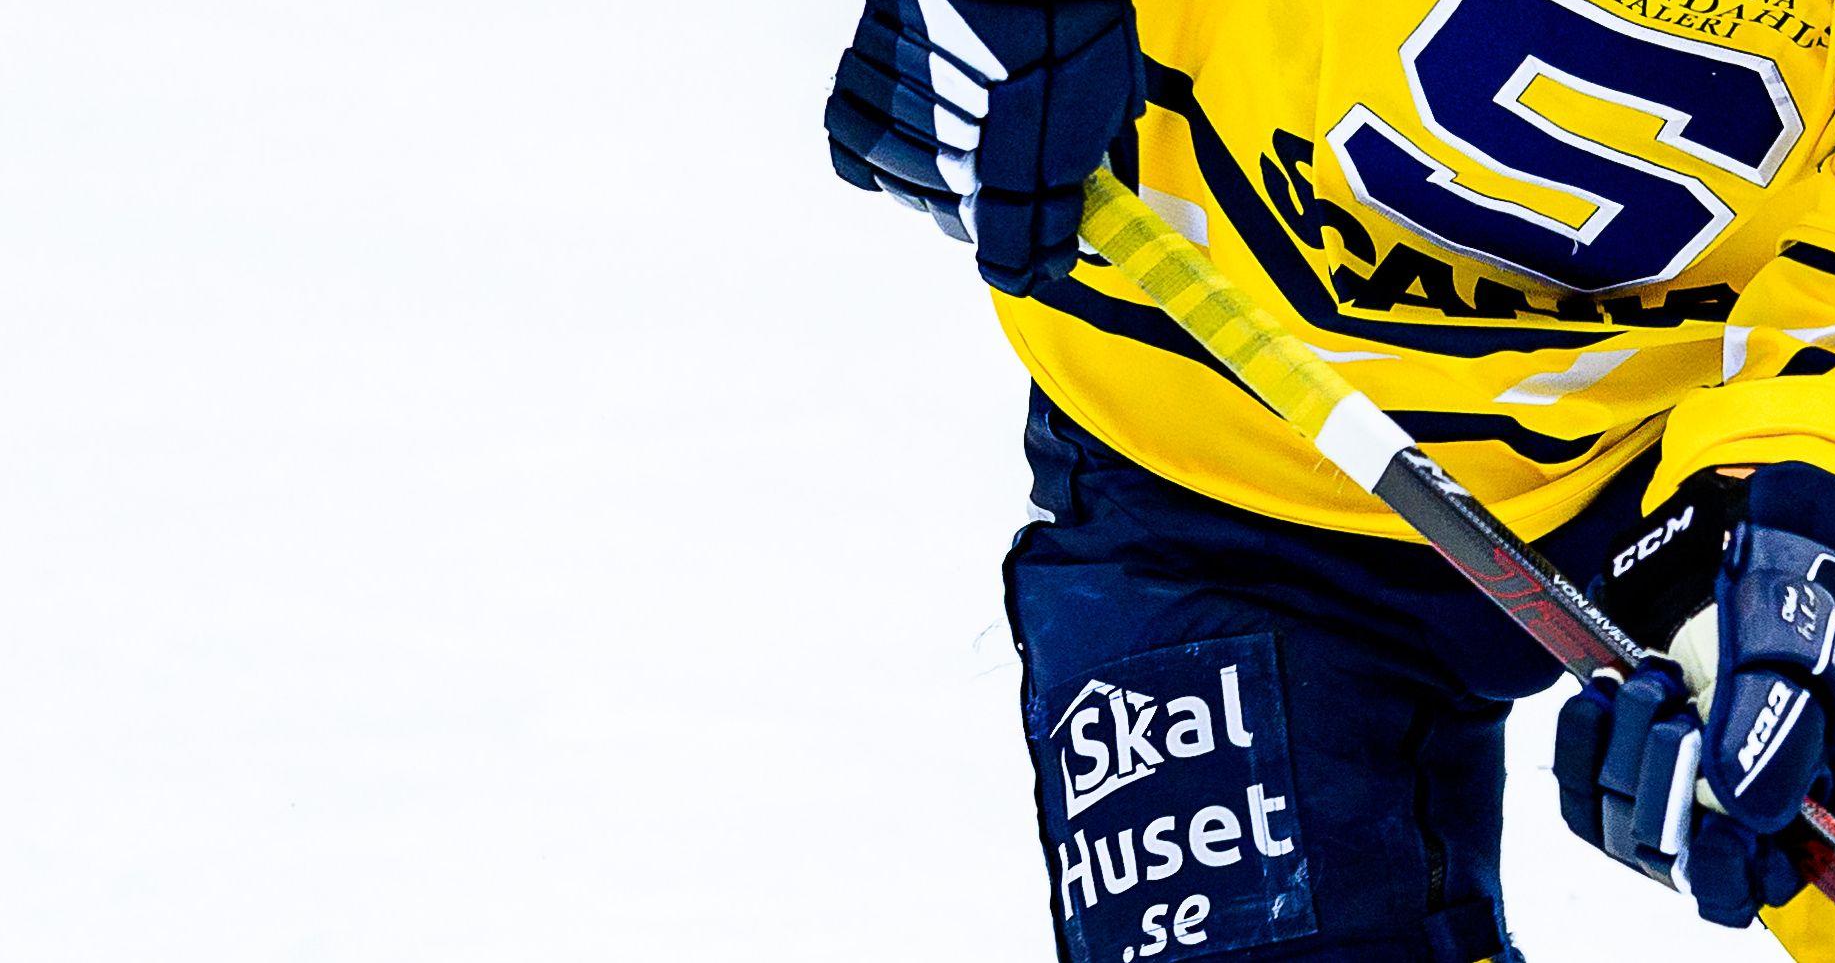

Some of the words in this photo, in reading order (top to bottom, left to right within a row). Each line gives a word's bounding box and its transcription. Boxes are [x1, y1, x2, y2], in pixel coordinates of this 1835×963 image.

[1613, 505, 1694, 578] CCM
[1070, 664, 1254, 791] Skal
[1058, 783, 1295, 921] Huset
[1122, 893, 1211, 963] .se
